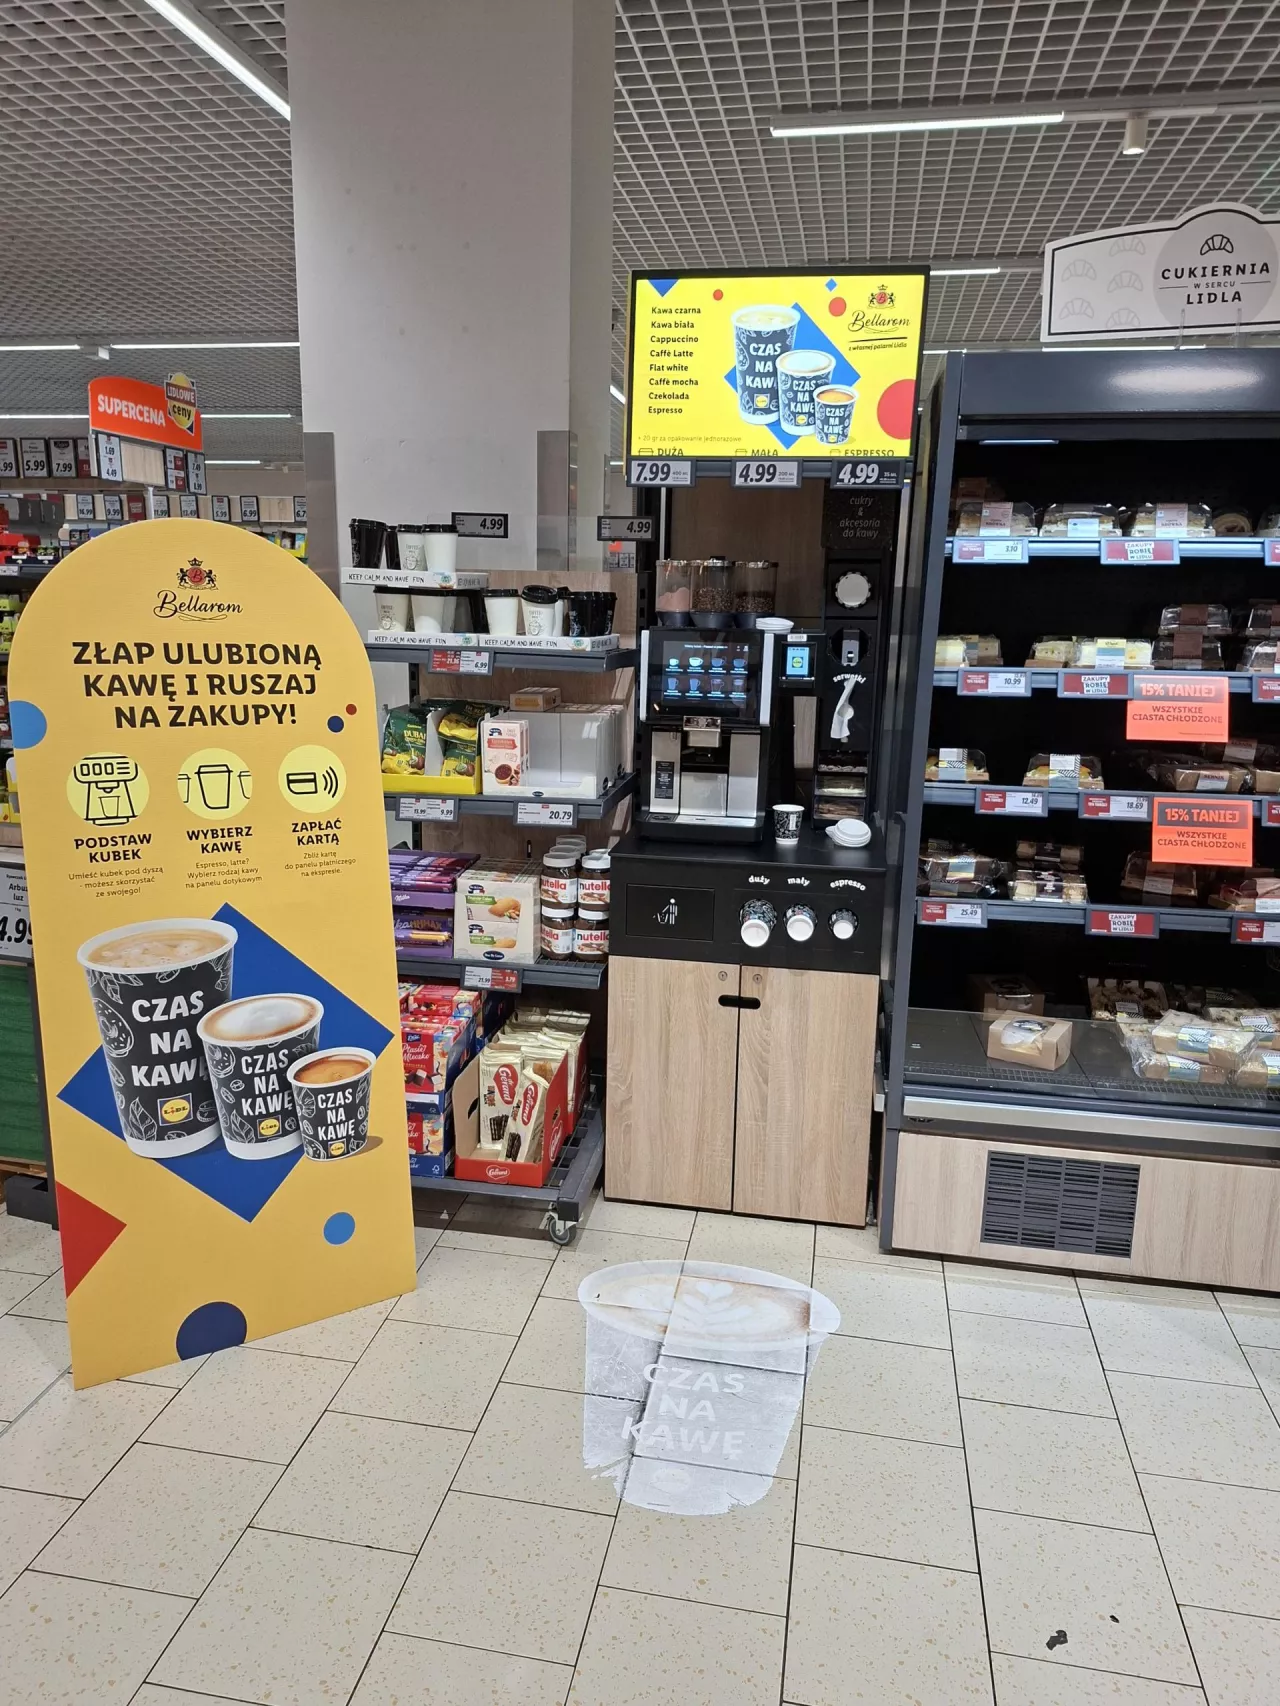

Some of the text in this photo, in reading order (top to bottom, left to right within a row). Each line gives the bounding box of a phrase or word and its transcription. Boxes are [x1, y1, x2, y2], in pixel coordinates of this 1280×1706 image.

[1161, 262, 1270, 280] CUKIERNIA
[1186, 291, 1242, 305] LIDLA
[651, 306, 673, 314] Kawa
[651, 320, 695, 329] Kawa biała
[848, 310, 910, 333] Bellarom
[650, 335, 699, 344] Cappuccino
[749, 343, 782, 356] CZAS
[649, 364, 689, 372] Flat white
[755, 360, 773, 373] NA
[672, 378, 699, 386] mocha
[793, 380, 816, 390] CZAS
[167, 386, 195, 402] LIDLOWE
[648, 392, 690, 400] Czekolada
[797, 391, 809, 402] NA
[97, 394, 166, 427] SUPERCENA
[172, 403, 191, 420] ceny
[648, 406, 683, 415] Espresso
[825, 408, 845, 417] CZAS
[829, 417, 839, 426] NA
[657, 446, 684, 456] DUŻA
[25, 460, 45, 471] 5.99
[55, 462, 72, 472] 7.99
[636, 462, 671, 482] 7.99
[738, 463, 777, 482] 4.99
[838, 463, 879, 483] 4.99
[850, 496, 873, 507] cukry
[480, 518, 503, 530] 4.99
[626, 521, 650, 533] 4.99
[856, 528, 879, 539] kawy
[153, 589, 243, 621] Bellarom
[72, 641, 322, 671] ZŁAP ULUBIONĄ
[83, 673, 317, 702] KAWĘ I RUSZAJ
[1004, 677, 1022, 685] 10.99
[1140, 683, 1216, 697] 15% TANIEJ
[114, 703, 297, 729] NA ZAKUPY!
[1152, 705, 1203, 714] WSZYSTKIE
[1132, 713, 1223, 723] CIASTA CHŁODZONE
[1021, 797, 1039, 805] 12.49
[549, 811, 572, 820] 20.79
[1165, 808, 1240, 823] 15% TANIEJ
[291, 817, 342, 833] ZAPŁAĆ
[186, 826, 253, 841] WYBIERZ
[297, 833, 340, 846] KARTĄ
[1176, 831, 1227, 840] WSZYSTKIE
[74, 833, 152, 849] PODSTAW
[200, 841, 242, 854] KAWĘ
[1157, 838, 1247, 849] CIASTA CHŁODZONE
[89, 848, 142, 863] KUBEK
[195, 857, 250, 869] Espresso, latte?
[295, 861, 318, 870] panelu
[319, 858, 357, 868] płatniczego
[68, 866, 164, 881] Umieść kubek pod dyszą
[187, 870, 216, 880] Wybierz
[218, 868, 240, 876] rodzaj
[748, 875, 770, 885] duży
[84, 876, 156, 889] możesz skorzystać
[196, 880, 221, 889] panelu
[222, 876, 263, 885] dotykowym
[787, 877, 810, 887] mały
[830, 879, 866, 891] espresso
[13, 893, 24, 901] luz
[131, 989, 205, 1023] CZAS
[149, 1029, 193, 1056] NA
[241, 1049, 289, 1075] CZAS
[253, 1073, 280, 1095] NA
[241, 1090, 293, 1117] KAWĘ
[317, 1088, 354, 1109] CZAS
[327, 1107, 346, 1125] NA
[317, 1120, 356, 1141] KAWĘ
[643, 1363, 745, 1393] CZAS
[659, 1394, 716, 1422] NA
[621, 1416, 746, 1462] KAWĘ
